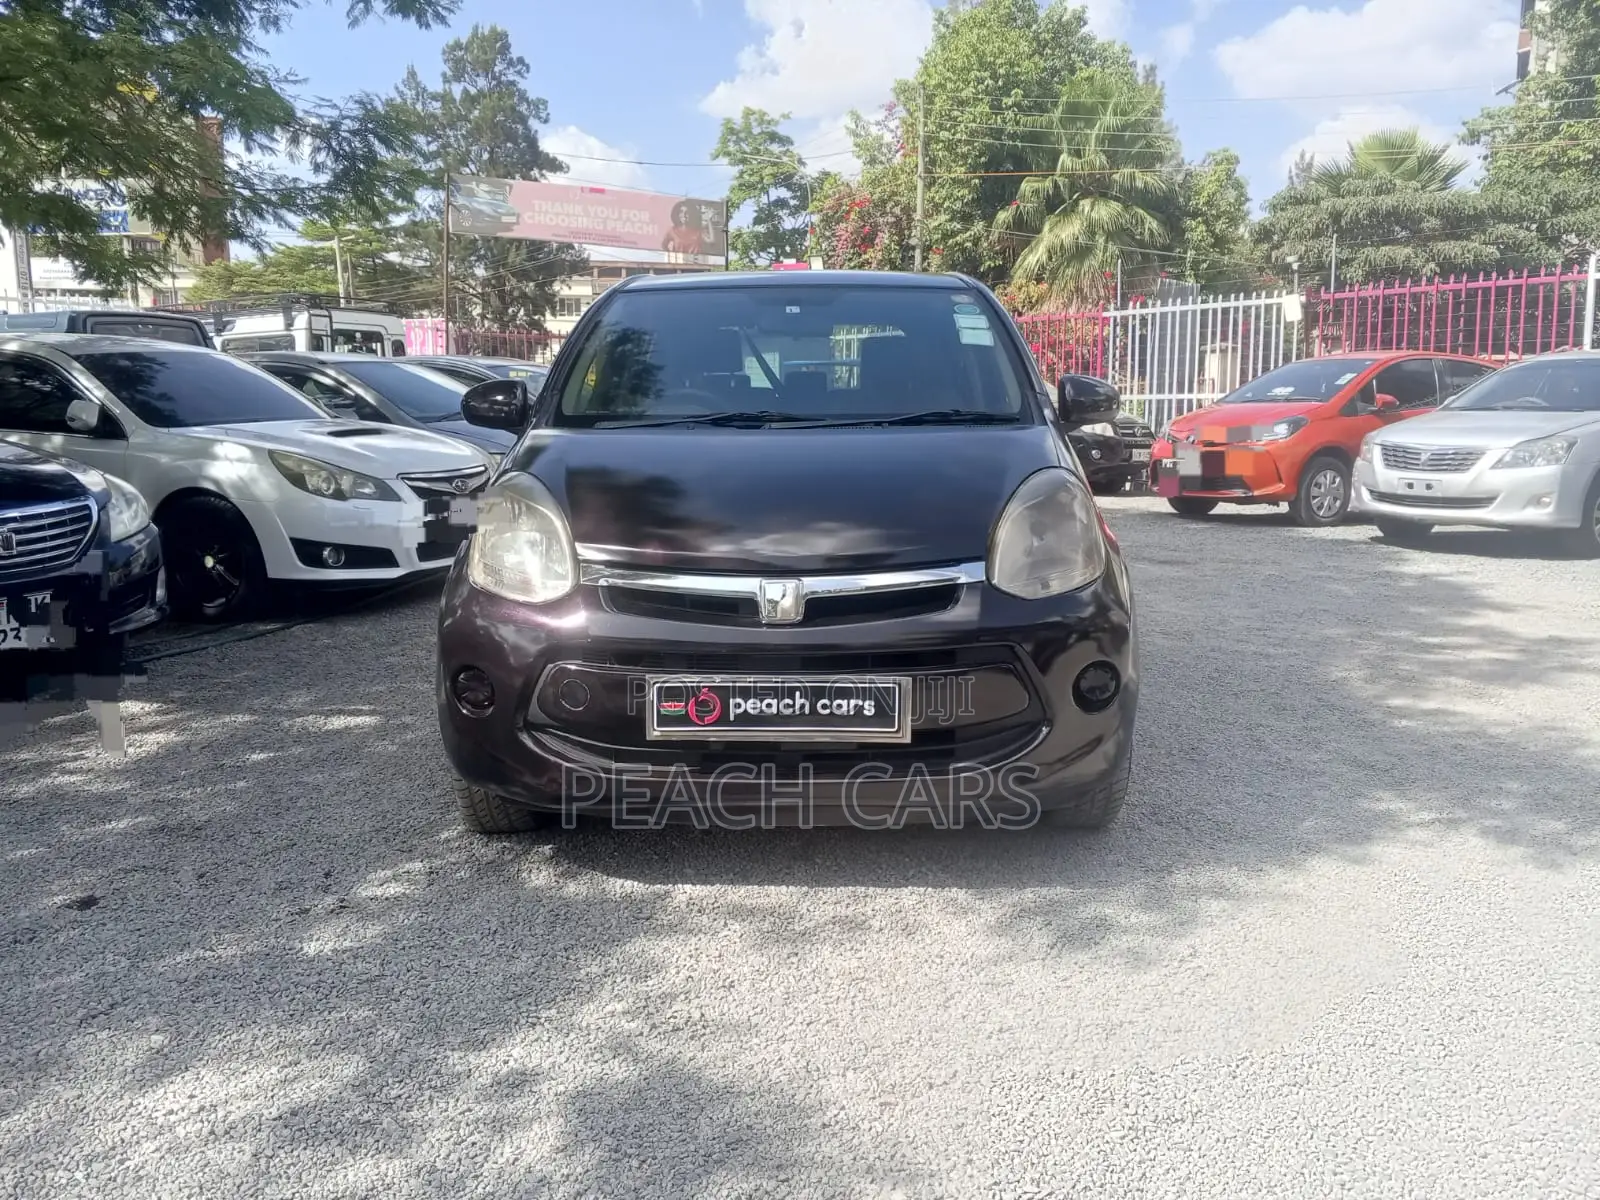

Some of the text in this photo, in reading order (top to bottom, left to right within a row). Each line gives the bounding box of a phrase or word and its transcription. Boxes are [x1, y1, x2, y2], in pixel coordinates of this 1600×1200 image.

[524, 211, 605, 230] CHOOSING
[606, 219, 658, 236] PEACH!
[532, 200, 651, 223] THANK YOU FOR
[729, 691, 875, 721] peach cars
